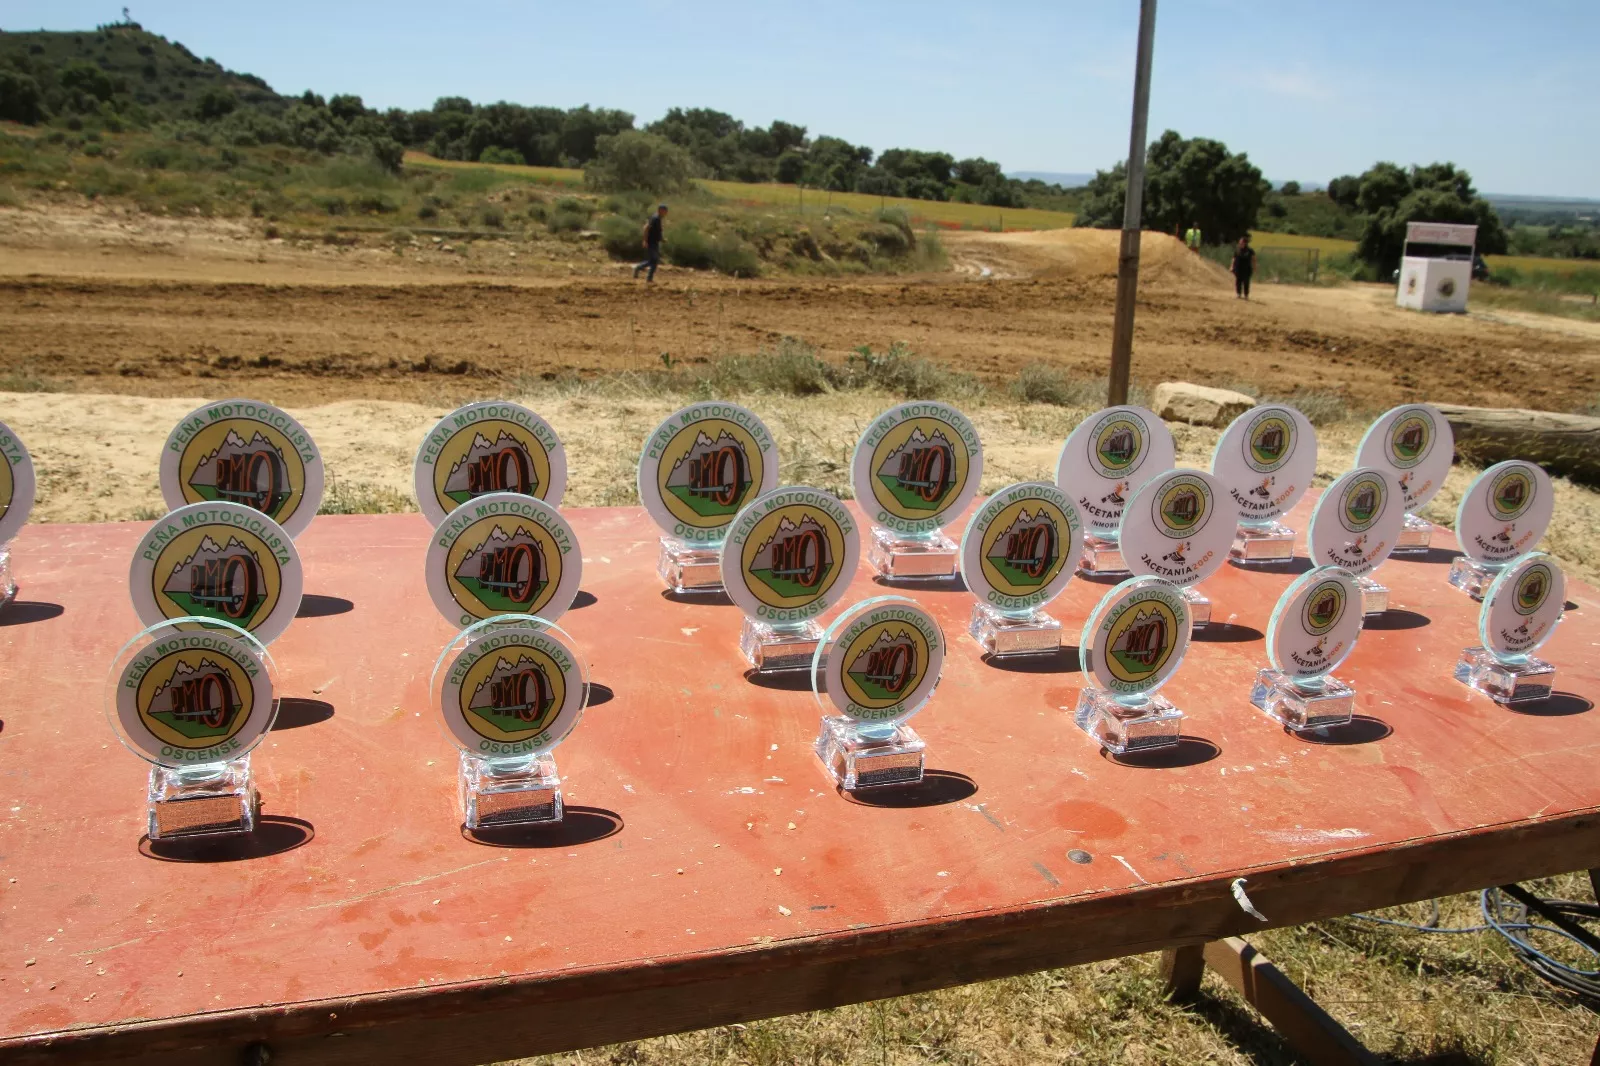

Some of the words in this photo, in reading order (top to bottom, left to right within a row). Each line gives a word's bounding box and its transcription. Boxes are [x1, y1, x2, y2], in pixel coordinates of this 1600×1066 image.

[171, 419, 204, 453] PEÑA
[208, 405, 315, 464] MOTOCICLISTA
[423, 428, 453, 465] PEÑA
[453, 406, 557, 452] MOTOCICLISTA
[650, 423, 678, 459] PEÑA
[680, 406, 771, 453] MOTOCICLISTA
[867, 416, 898, 448] PEÑA
[901, 405, 978, 457] MOTOCICLISTA
[439, 514, 473, 549] PEÑA
[475, 501, 573, 555] MOTOCICLISTA
[734, 511, 762, 545] PEÑA
[764, 492, 852, 536] MOTOCICLISTA
[877, 511, 945, 533] OSCENSE
[977, 501, 1006, 532] PEÑA
[1008, 487, 1080, 532] MOTOCICLISTA
[143, 524, 179, 561] PEÑA
[182, 510, 291, 566] MOTOCICLISTA
[674, 523, 727, 541] OSCEN
[756, 597, 828, 621] OSCENSE
[987, 589, 1049, 608] OSCENSE
[1128, 590, 1185, 626] MOTOCICLISTA
[840, 621, 868, 649] PEÑA
[871, 610, 938, 651] MOTOCICLISTA
[126, 655, 155, 689] PEÑA
[156, 637, 261, 678] MOTOCICLISTA
[450, 652, 478, 685] PEÑA
[479, 634, 572, 673] MOTOCICLISTA
[1109, 674, 1159, 693] OSCENSE
[846, 702, 905, 719] OSCENSE
[161, 737, 241, 761] OSCENSE
[479, 731, 552, 754] OSCENSE
